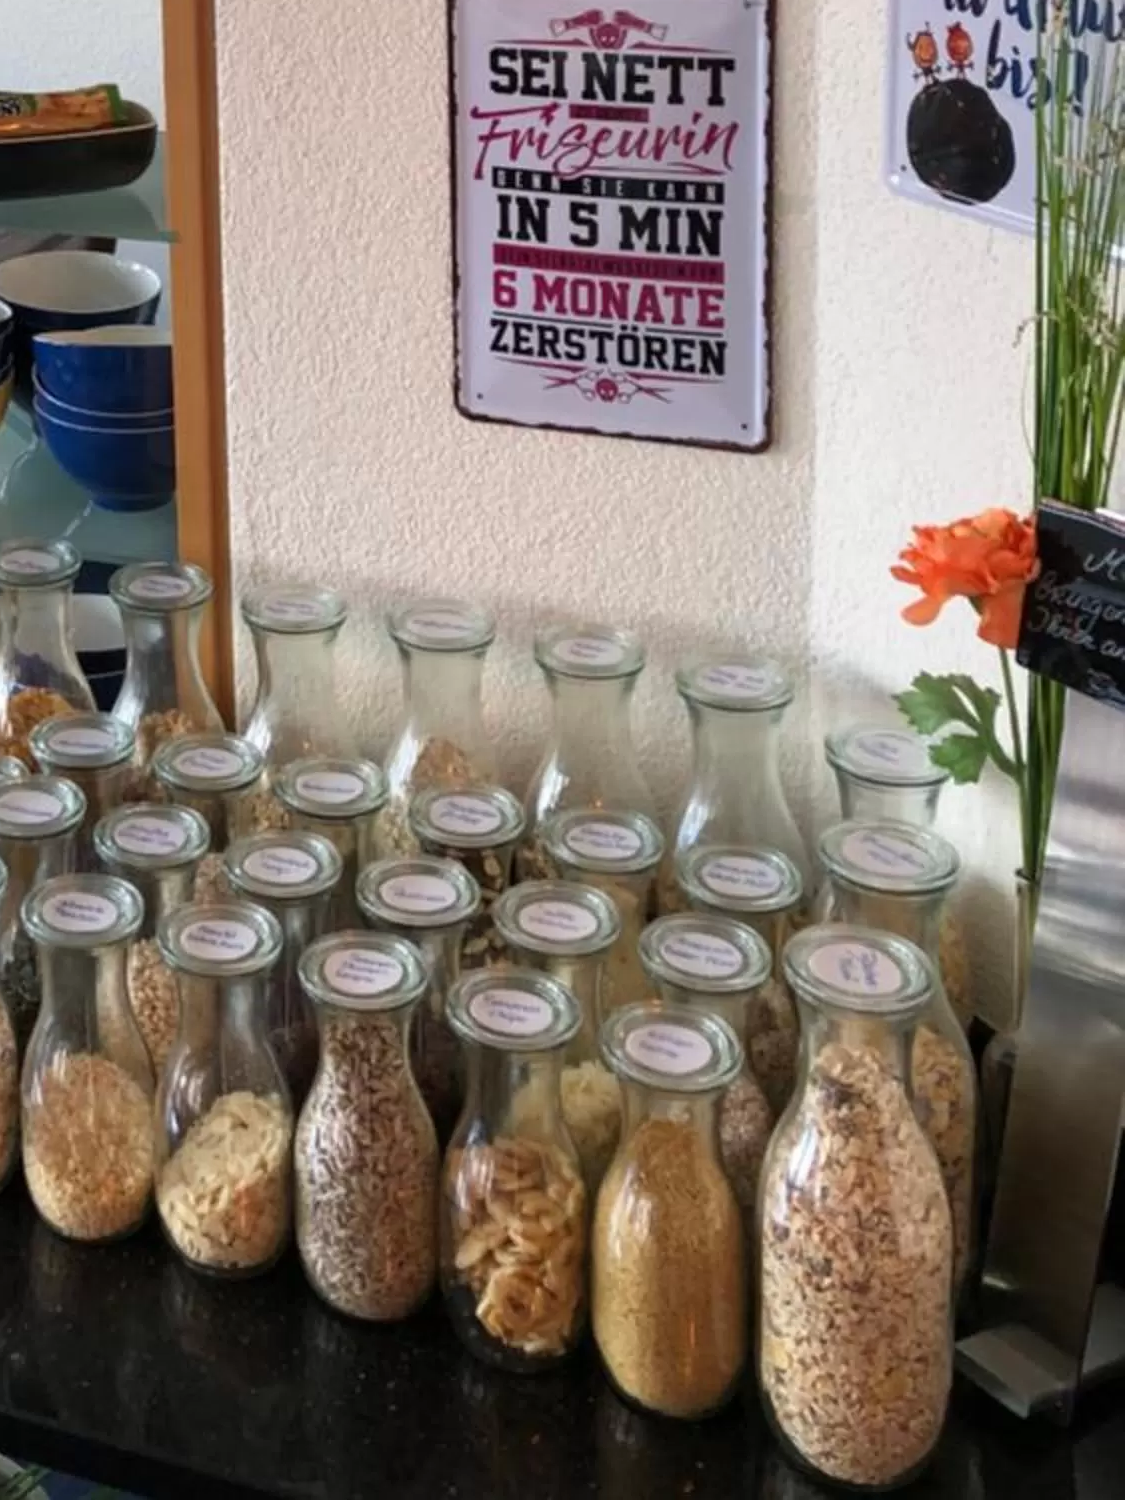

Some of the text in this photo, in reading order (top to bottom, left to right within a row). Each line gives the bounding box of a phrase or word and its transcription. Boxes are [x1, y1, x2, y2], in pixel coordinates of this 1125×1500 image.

[489, 47, 737, 108] SEI NETT
[470, 102, 740, 181] Friseurin
[497, 168, 718, 200] DENN SIE KANN
[497, 194, 724, 257] IN 5 MIN
[492, 269, 725, 329] 6 MONATE
[490, 318, 728, 377] ZERSTÖREN
